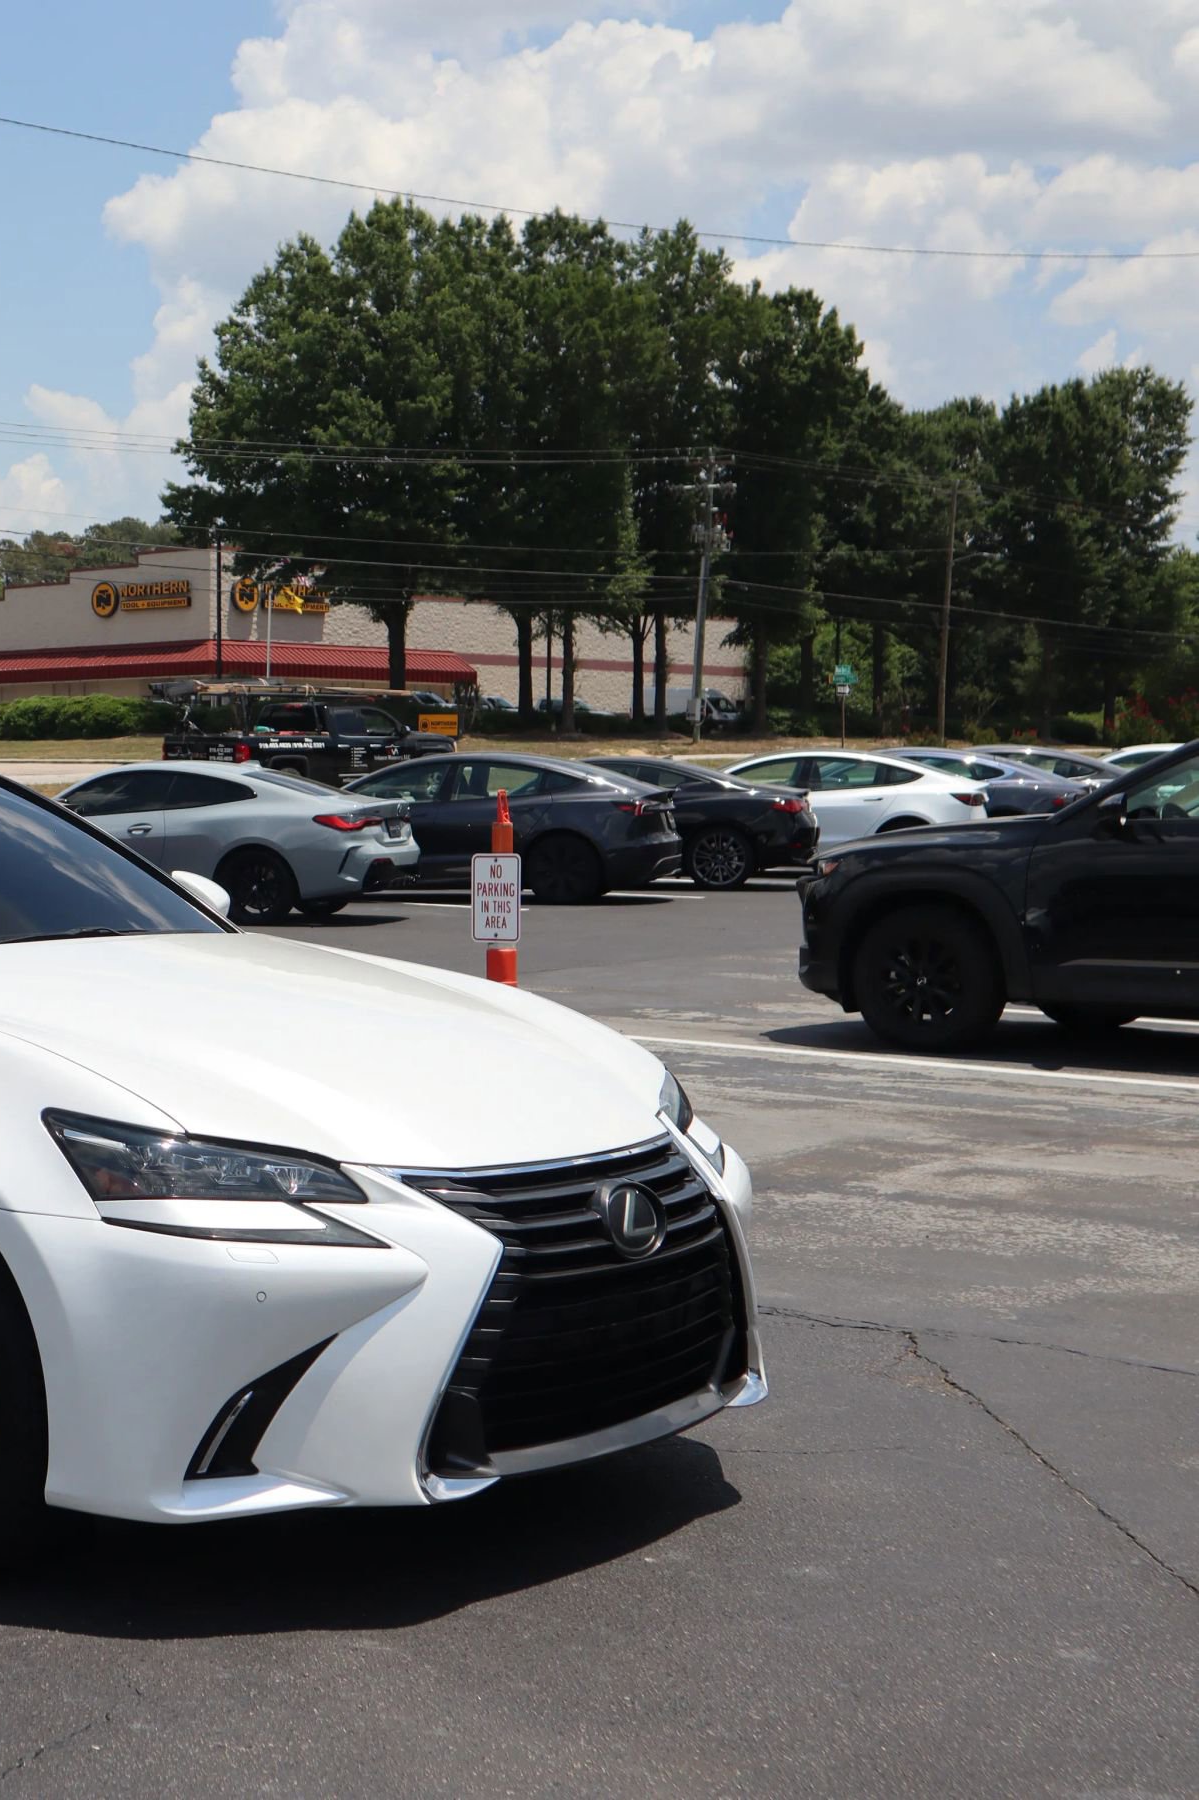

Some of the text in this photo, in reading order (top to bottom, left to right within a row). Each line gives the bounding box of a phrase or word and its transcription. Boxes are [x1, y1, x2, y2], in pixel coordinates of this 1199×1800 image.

[120, 580, 189, 597] NORTHERN
[146, 599, 186, 608] EQUIPMENT
[490, 864, 502, 879] NO
[477, 882, 515, 897] PARKING
[481, 900, 511, 914] IN THIS
[485, 916, 507, 929] AREA
